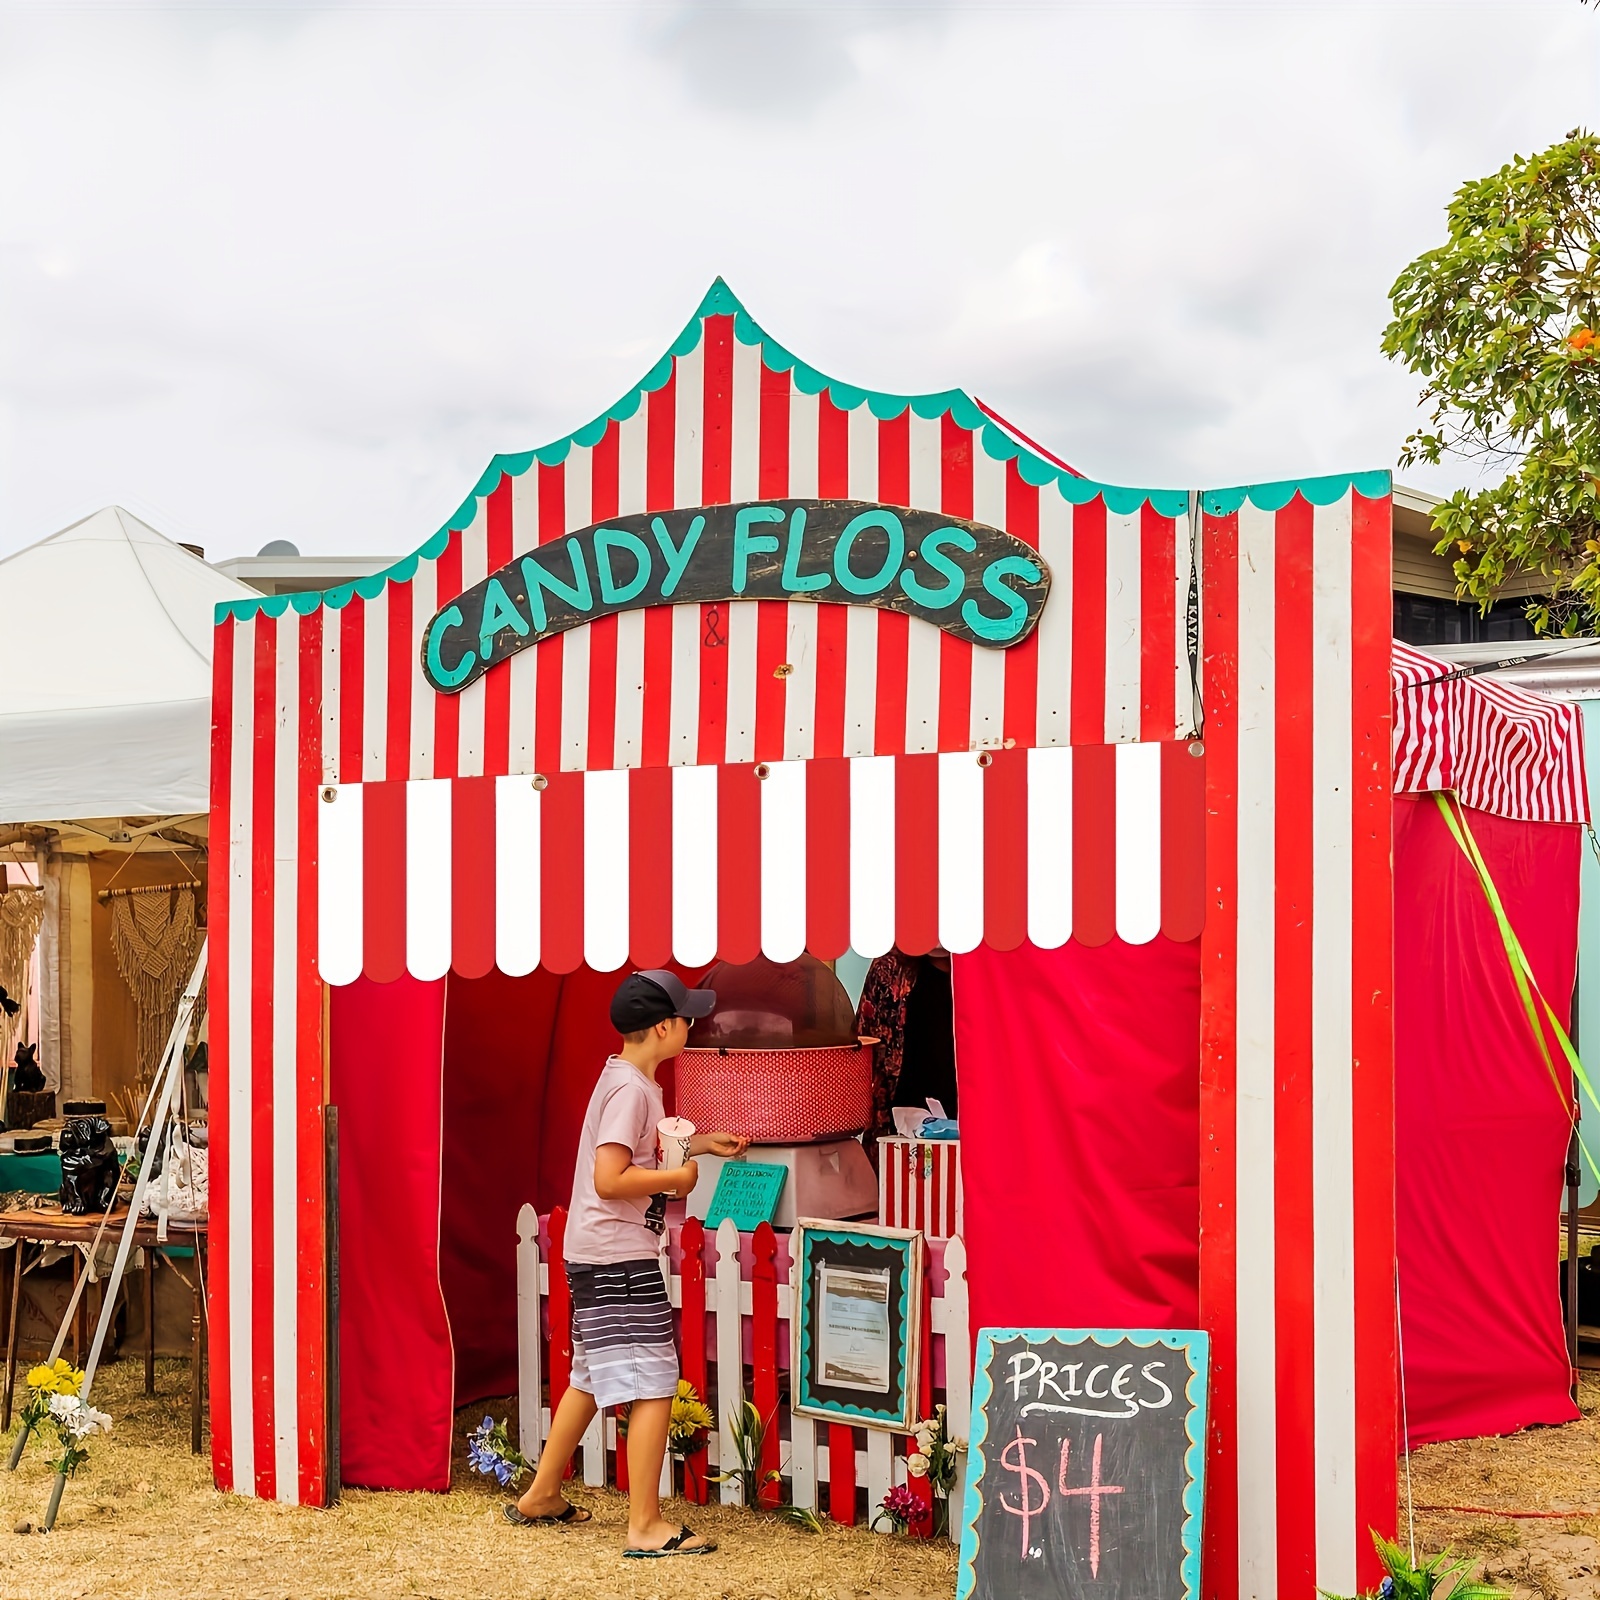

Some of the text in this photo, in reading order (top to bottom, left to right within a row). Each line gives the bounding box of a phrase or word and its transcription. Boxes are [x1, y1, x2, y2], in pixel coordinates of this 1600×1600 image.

[425, 506, 1042, 688] CANDY FLOSS
[1187, 604, 1198, 657] KAYAK
[726, 1168, 740, 1177] DID
[1005, 1351, 1173, 1409] PRICES
[999, 1424, 1126, 1580] $4
